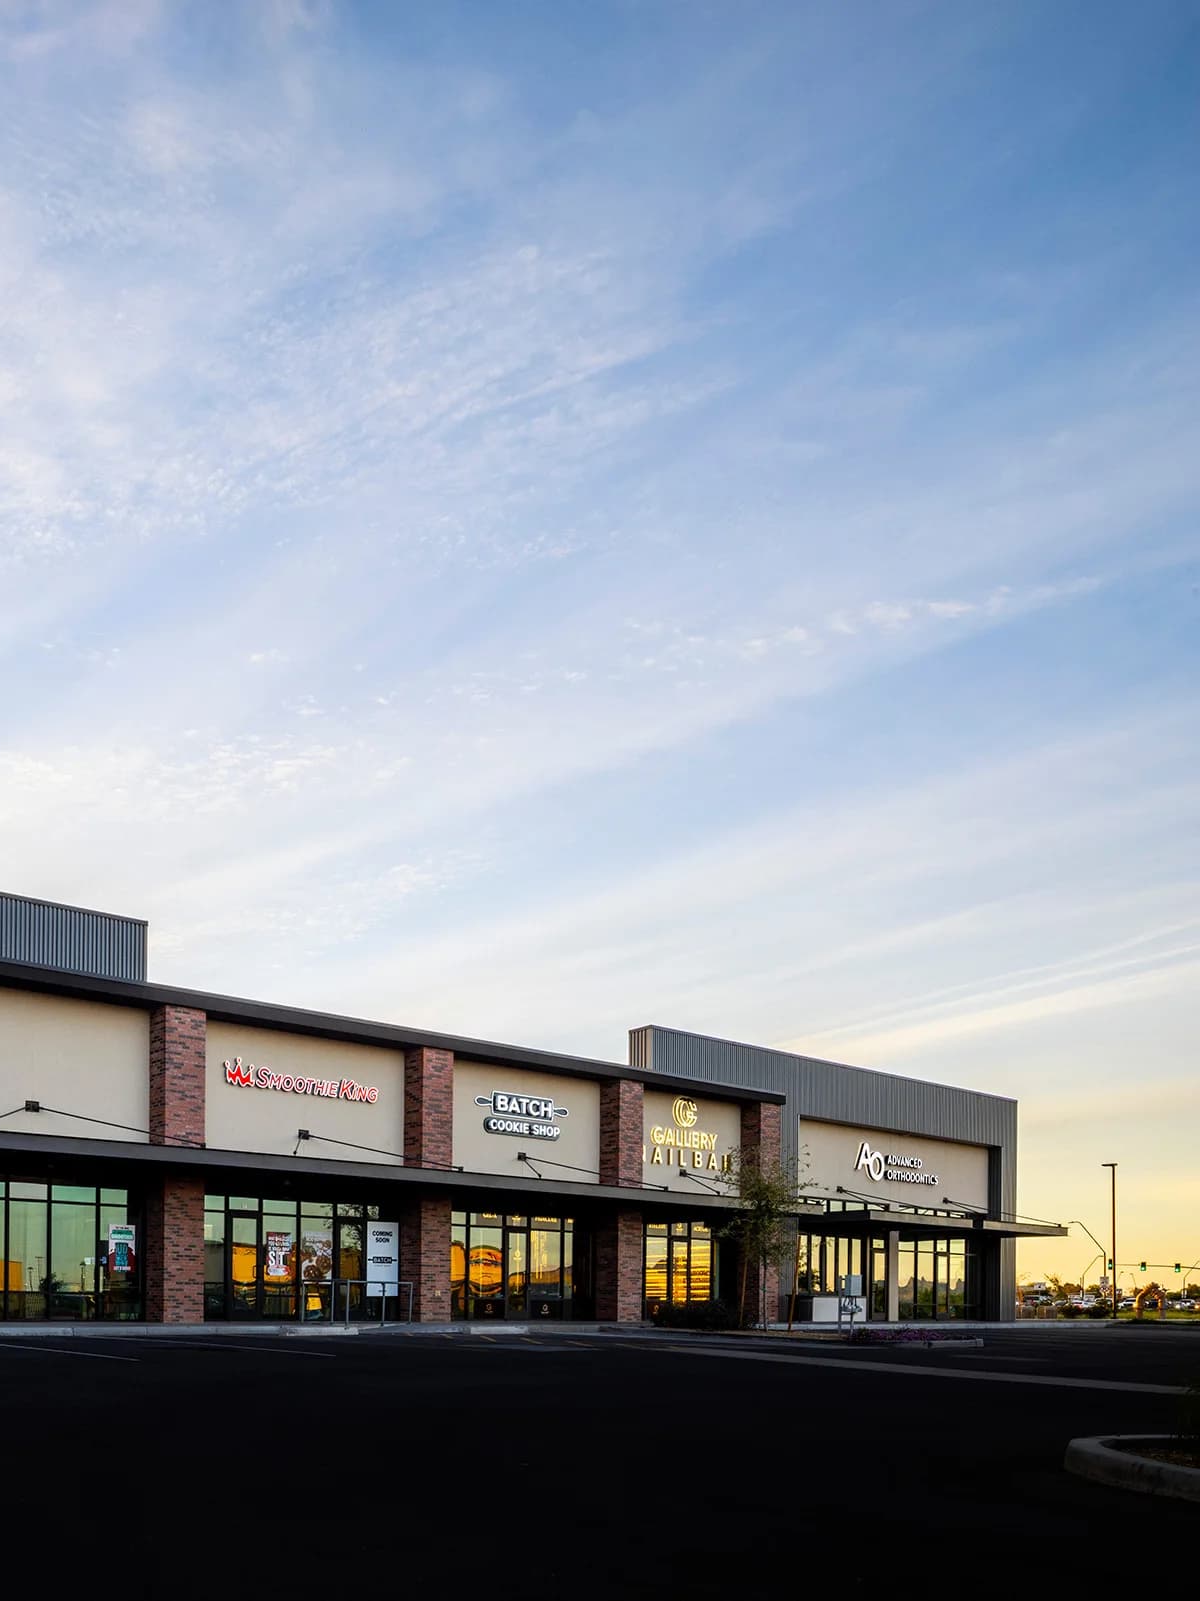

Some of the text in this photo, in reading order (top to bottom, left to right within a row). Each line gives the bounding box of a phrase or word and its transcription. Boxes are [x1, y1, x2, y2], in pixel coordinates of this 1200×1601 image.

[255, 1066, 339, 1097] SMOOTHIE
[496, 1095, 552, 1118] BATCH
[489, 1118, 561, 1137] COOKIE SHOP
[650, 1126, 718, 1150] GALLERY
[887, 1154, 923, 1169] ADVANCED
[886, 1170, 939, 1185] ORTHODONTICS
